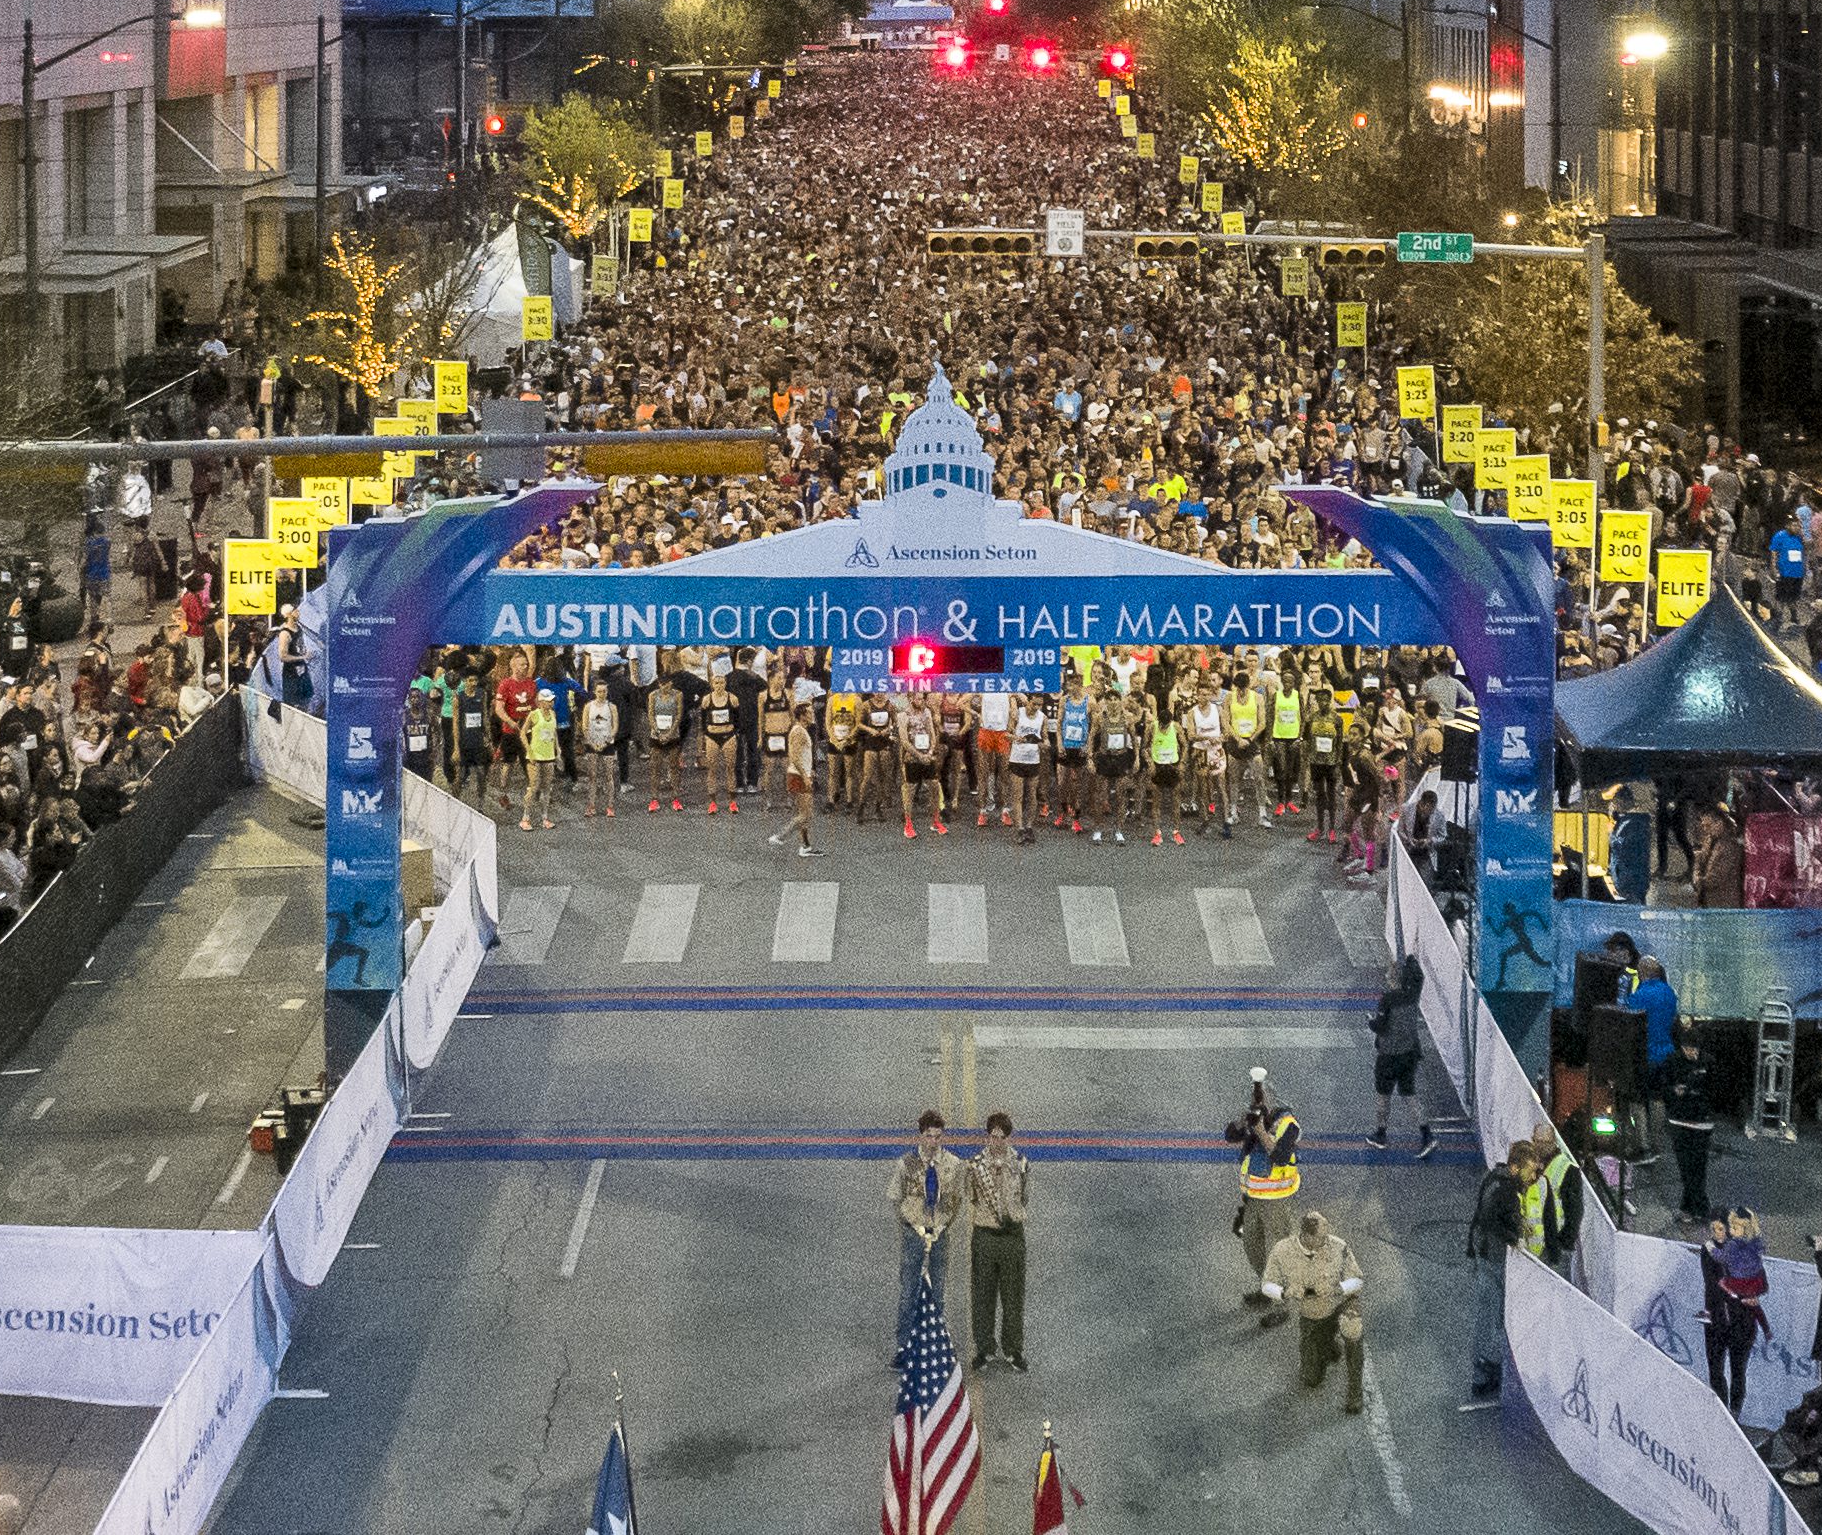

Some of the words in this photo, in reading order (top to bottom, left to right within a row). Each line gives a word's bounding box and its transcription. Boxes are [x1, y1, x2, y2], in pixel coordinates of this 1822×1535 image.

[1413, 235, 1442, 250] 2nd
[1445, 235, 1459, 245] ST
[442, 375, 461, 383] PACE
[441, 385, 462, 396] 3:25
[1405, 389, 1428, 400] 3:25
[1451, 420, 1473, 428] PACE
[414, 425, 429, 436] 20
[1449, 431, 1474, 443] 3:20
[1483, 444, 1507, 453] PACE
[1482, 457, 1507, 468] 3:15
[1516, 473, 1540, 481] PACE
[1514, 485, 1543, 498] 3:10
[317, 495, 341, 508] :05
[1559, 498, 1585, 507] PACE
[281, 517, 308, 527] PACE
[1556, 510, 1587, 524] 3:05
[278, 531, 311, 544] 3:00
[1612, 530, 1639, 540] PACE
[885, 545, 980, 561] Ascension
[985, 545, 1038, 561] Seton
[1608, 543, 1642, 558] 3:00
[229, 570, 274, 585] ELITE
[1661, 581, 1705, 597] ELITE
[341, 614, 396, 625] Ascension
[942, 599, 978, 643] &
[998, 603, 1102, 640] HALF
[1115, 603, 1381, 640] MARATHON
[1486, 613, 1540, 624] Ascension
[341, 626, 372, 636] Seton
[1485, 625, 1516, 636] Seton
[840, 649, 883, 665] 2019
[1013, 649, 1056, 665] 2019
[843, 678, 932, 692] AUSTIN
[969, 678, 1045, 692] TEXAS
[148, 1307, 222, 1341] Seto
[1608, 1401, 1718, 1515] Ascension
